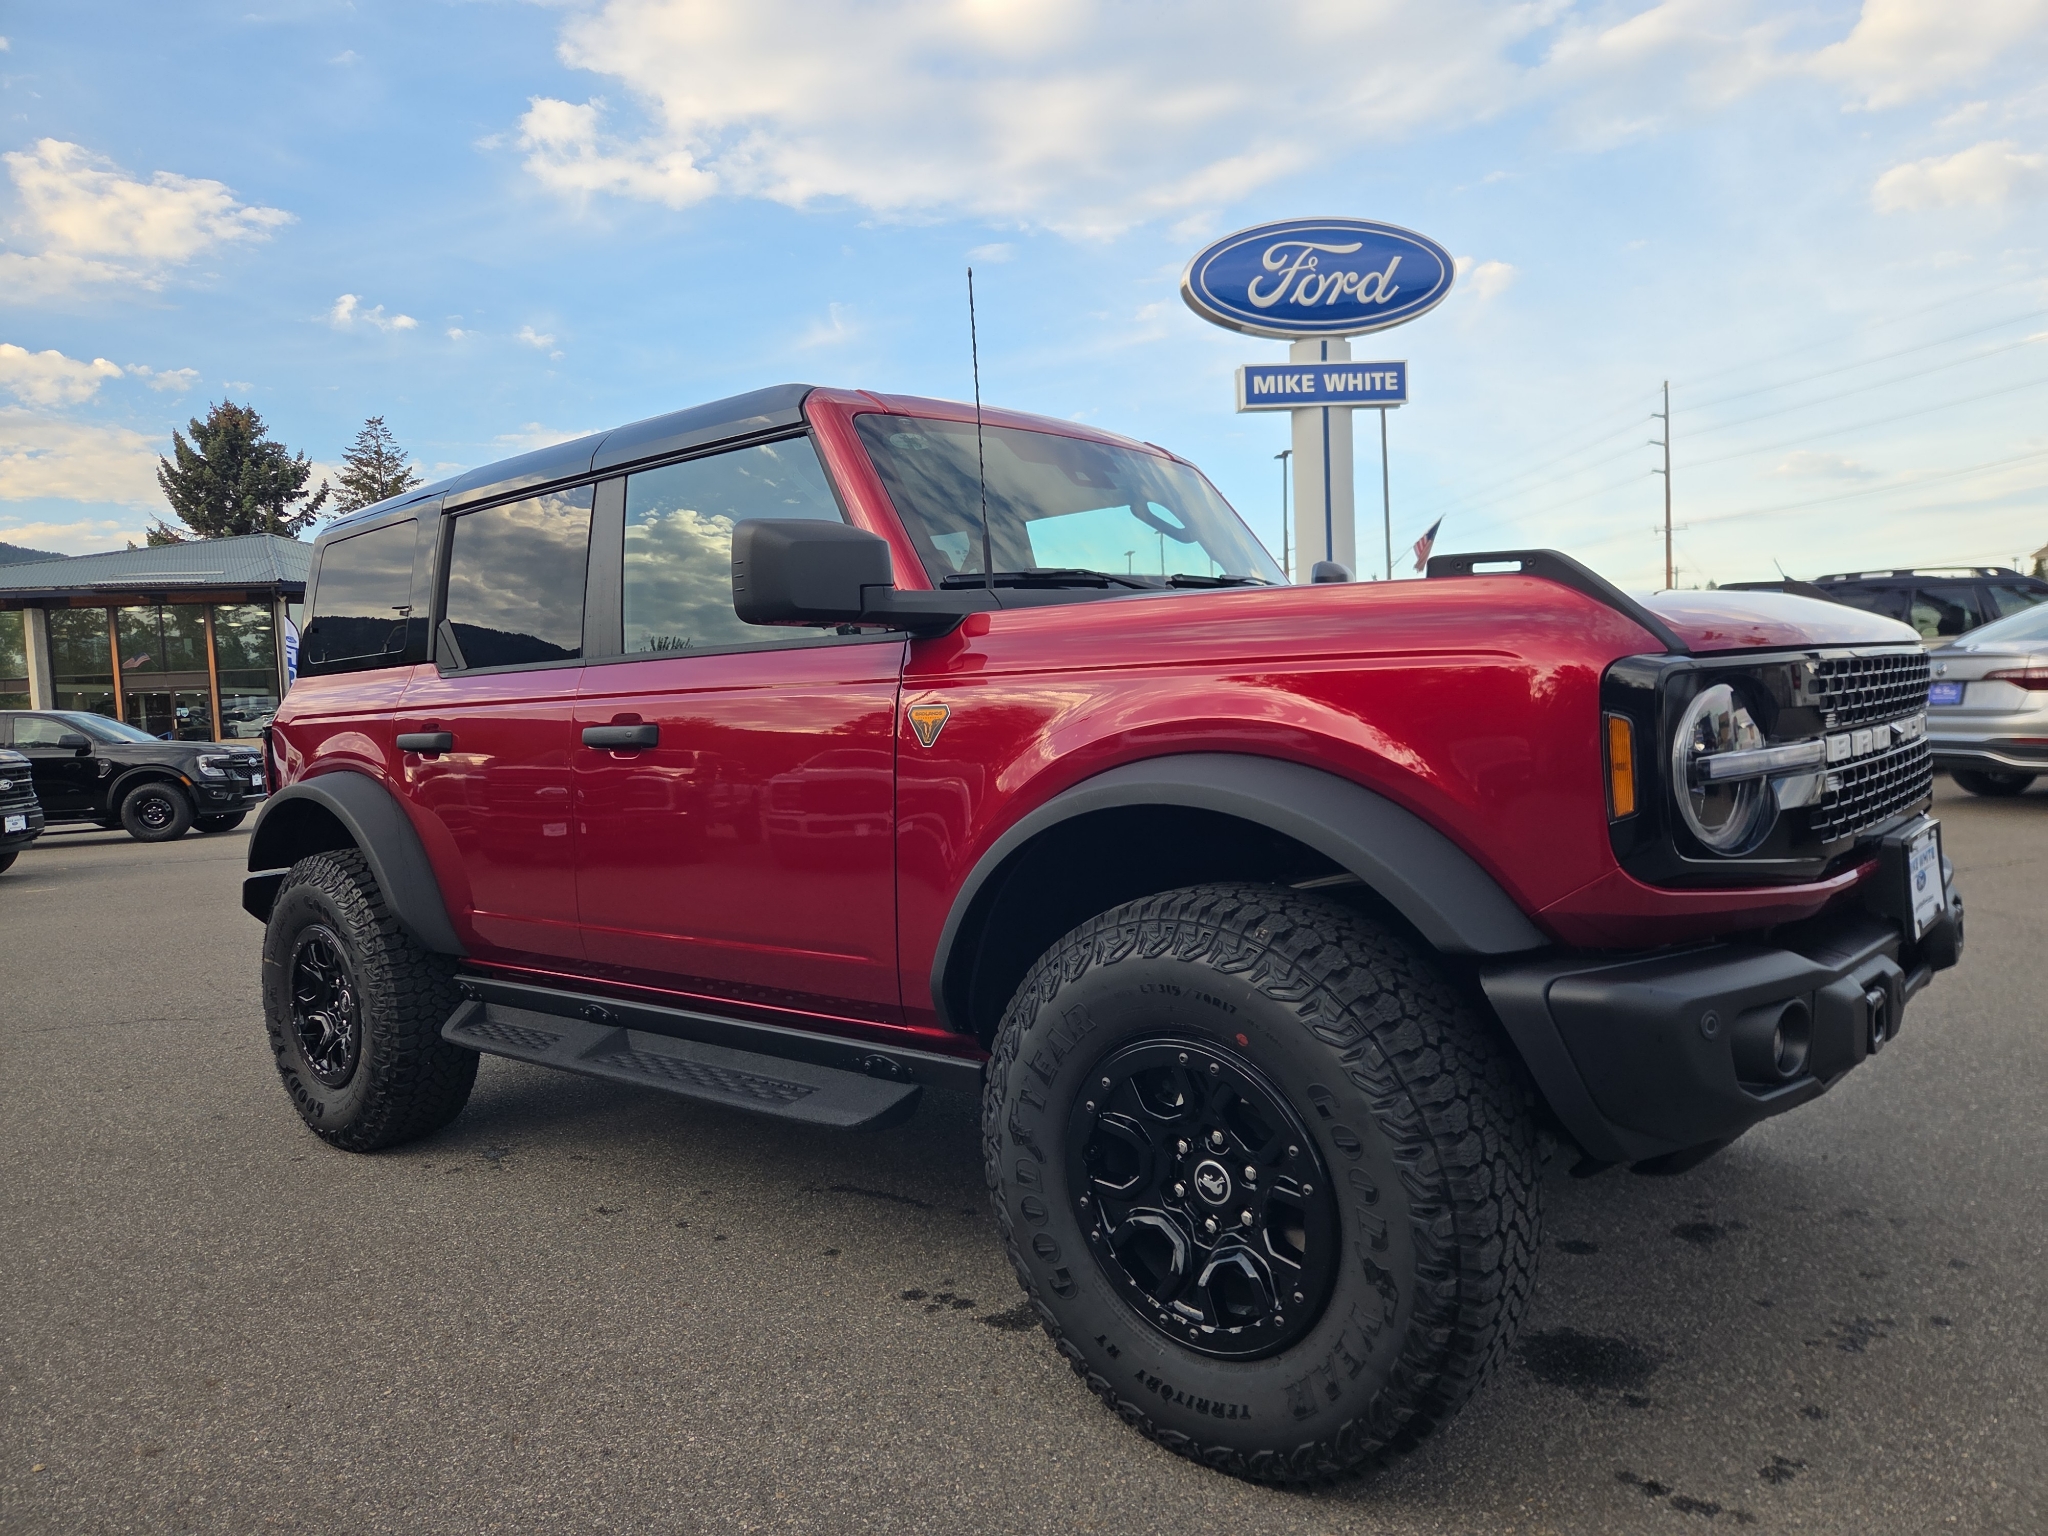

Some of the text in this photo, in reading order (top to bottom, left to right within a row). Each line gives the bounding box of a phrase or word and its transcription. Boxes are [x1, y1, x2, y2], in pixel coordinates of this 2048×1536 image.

[1248, 241, 1402, 308] Ford
[1253, 371, 1399, 395] MIKE WHITE
[1009, 1002, 1097, 1299] GOODYEAR
[1094, 1334, 1252, 1420] TERRITORY RT
